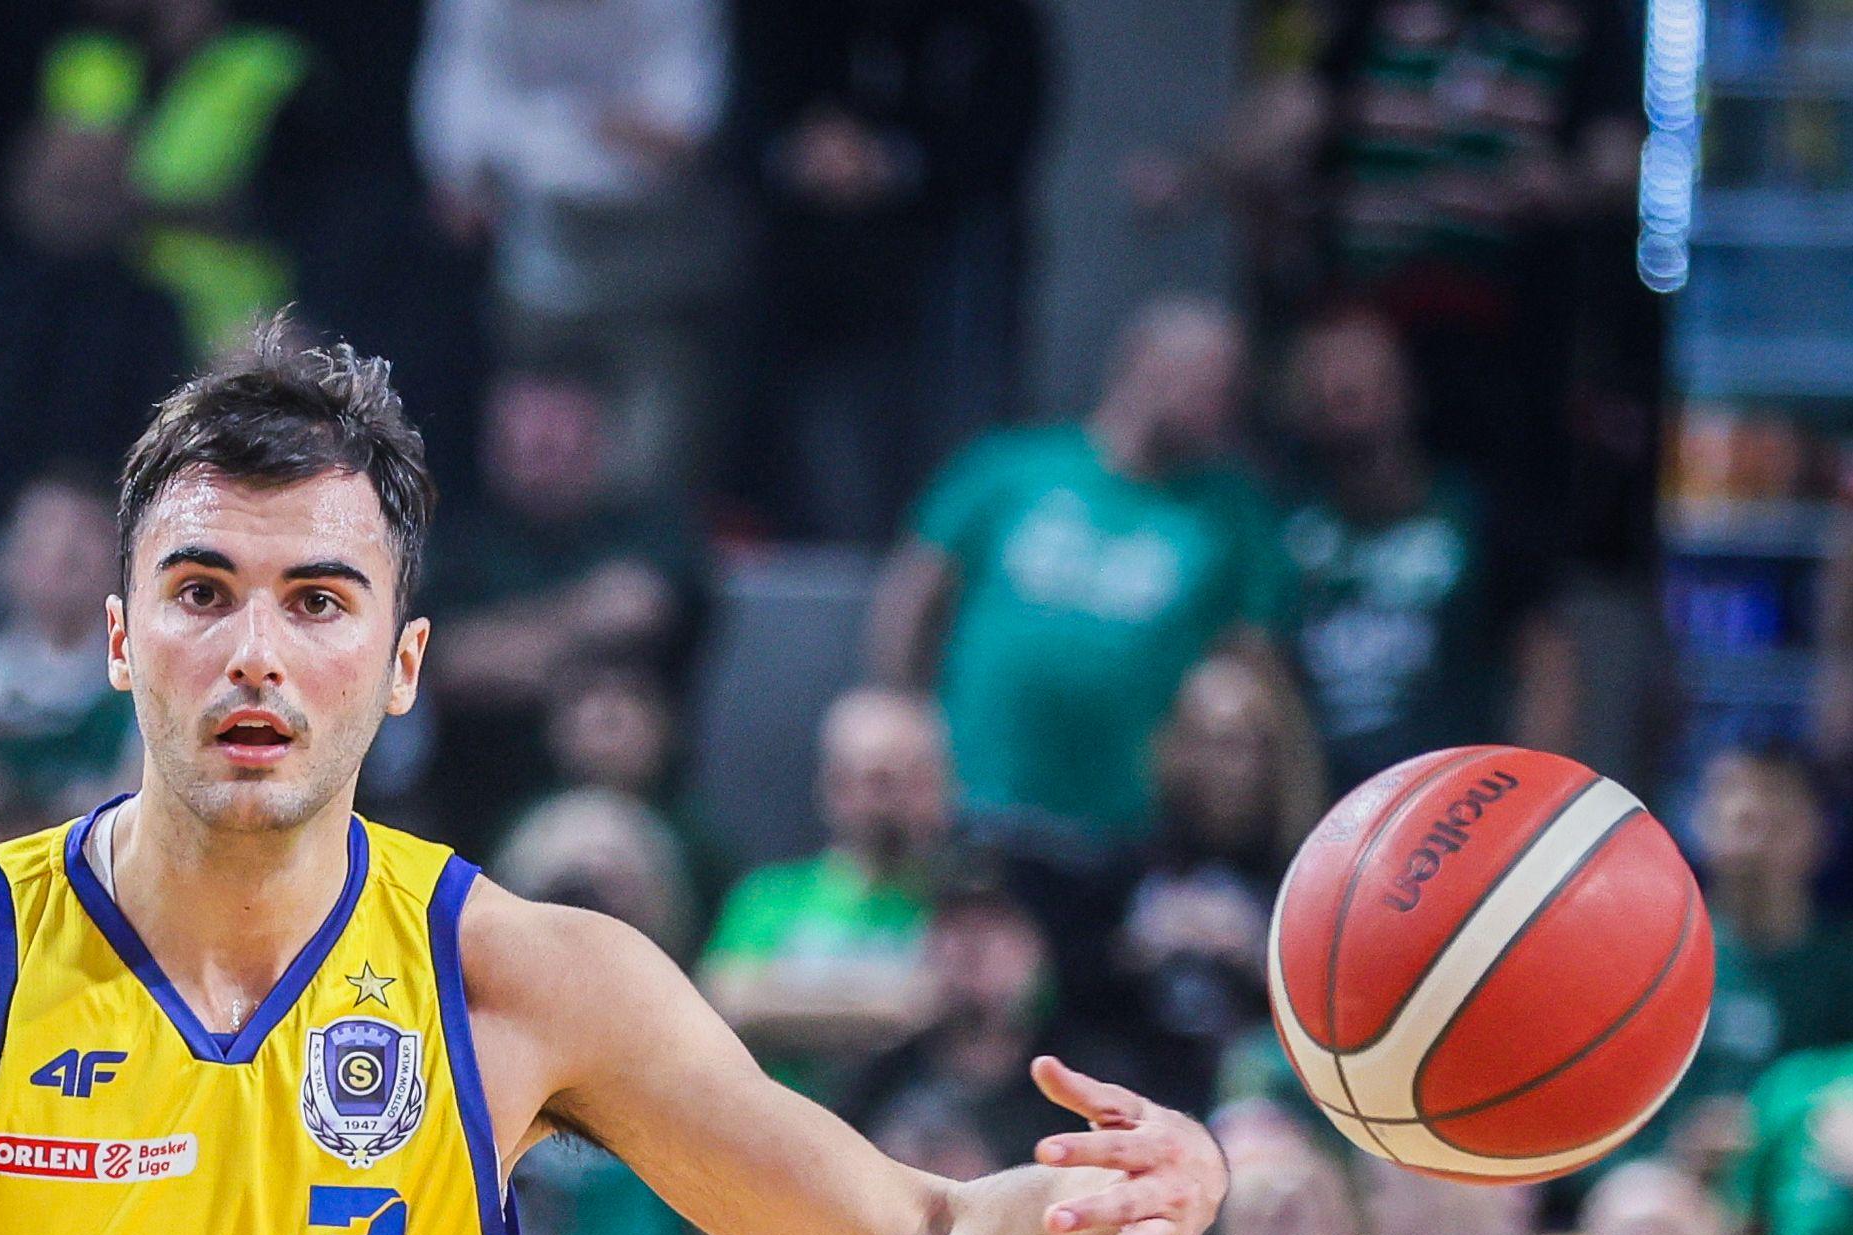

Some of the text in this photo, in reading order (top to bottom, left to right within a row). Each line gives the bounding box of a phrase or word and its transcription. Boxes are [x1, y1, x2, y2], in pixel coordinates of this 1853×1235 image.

[1381, 769, 1520, 914] molten
[29, 1048, 129, 1098] 4F
[347, 1057, 374, 1089] S
[343, 1120, 379, 1131] 1947
[138, 1139, 188, 1159] Basket
[138, 1160, 171, 1176] Liga
